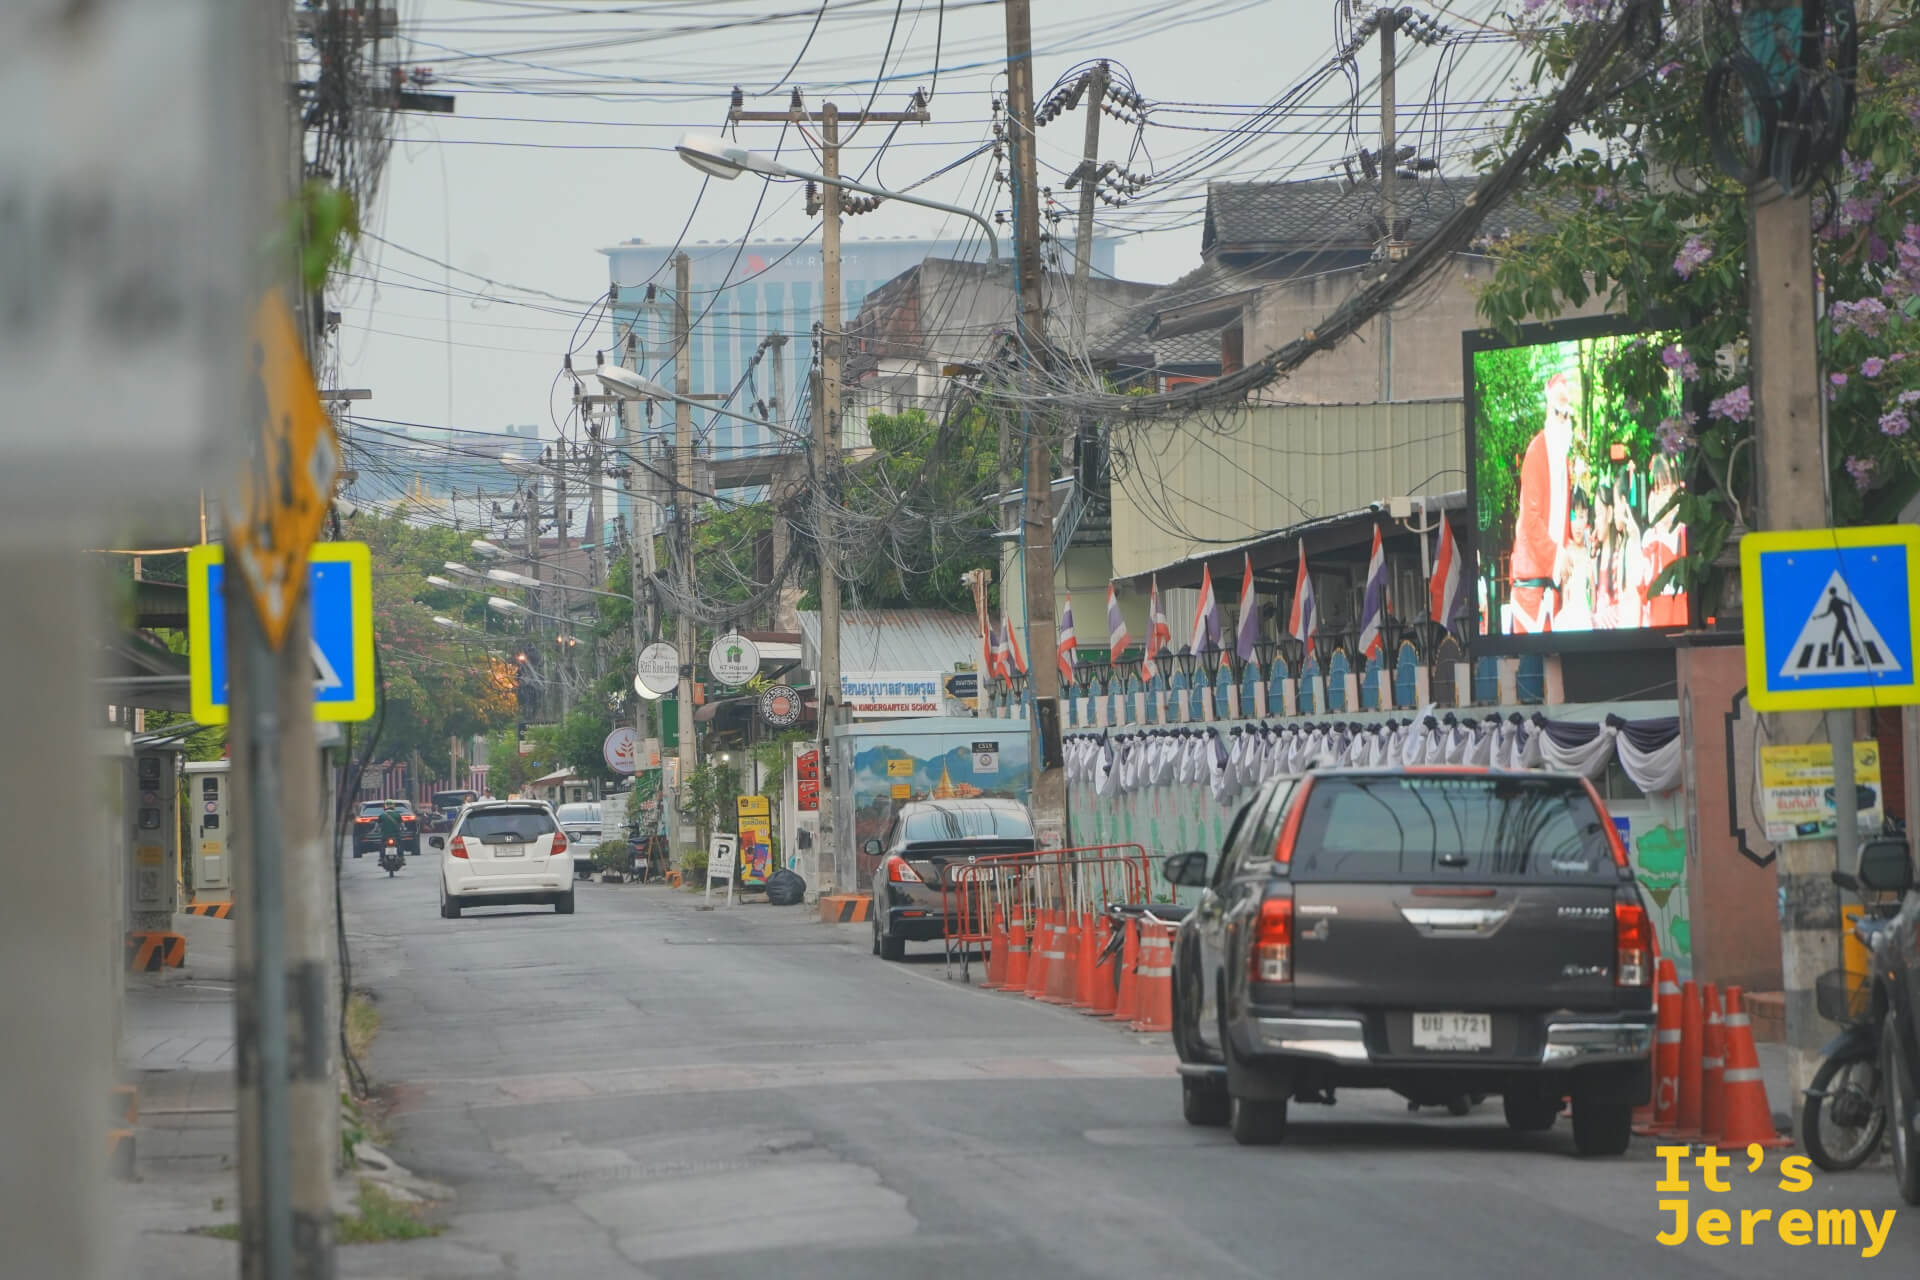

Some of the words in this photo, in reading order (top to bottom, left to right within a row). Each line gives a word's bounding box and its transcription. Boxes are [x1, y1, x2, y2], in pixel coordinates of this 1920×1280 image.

[858, 703, 910, 712] KINDERGARTEN
[911, 703, 937, 712] SCHOOL
[717, 844, 730, 859] P
[1454, 1015, 1487, 1032] 1721
